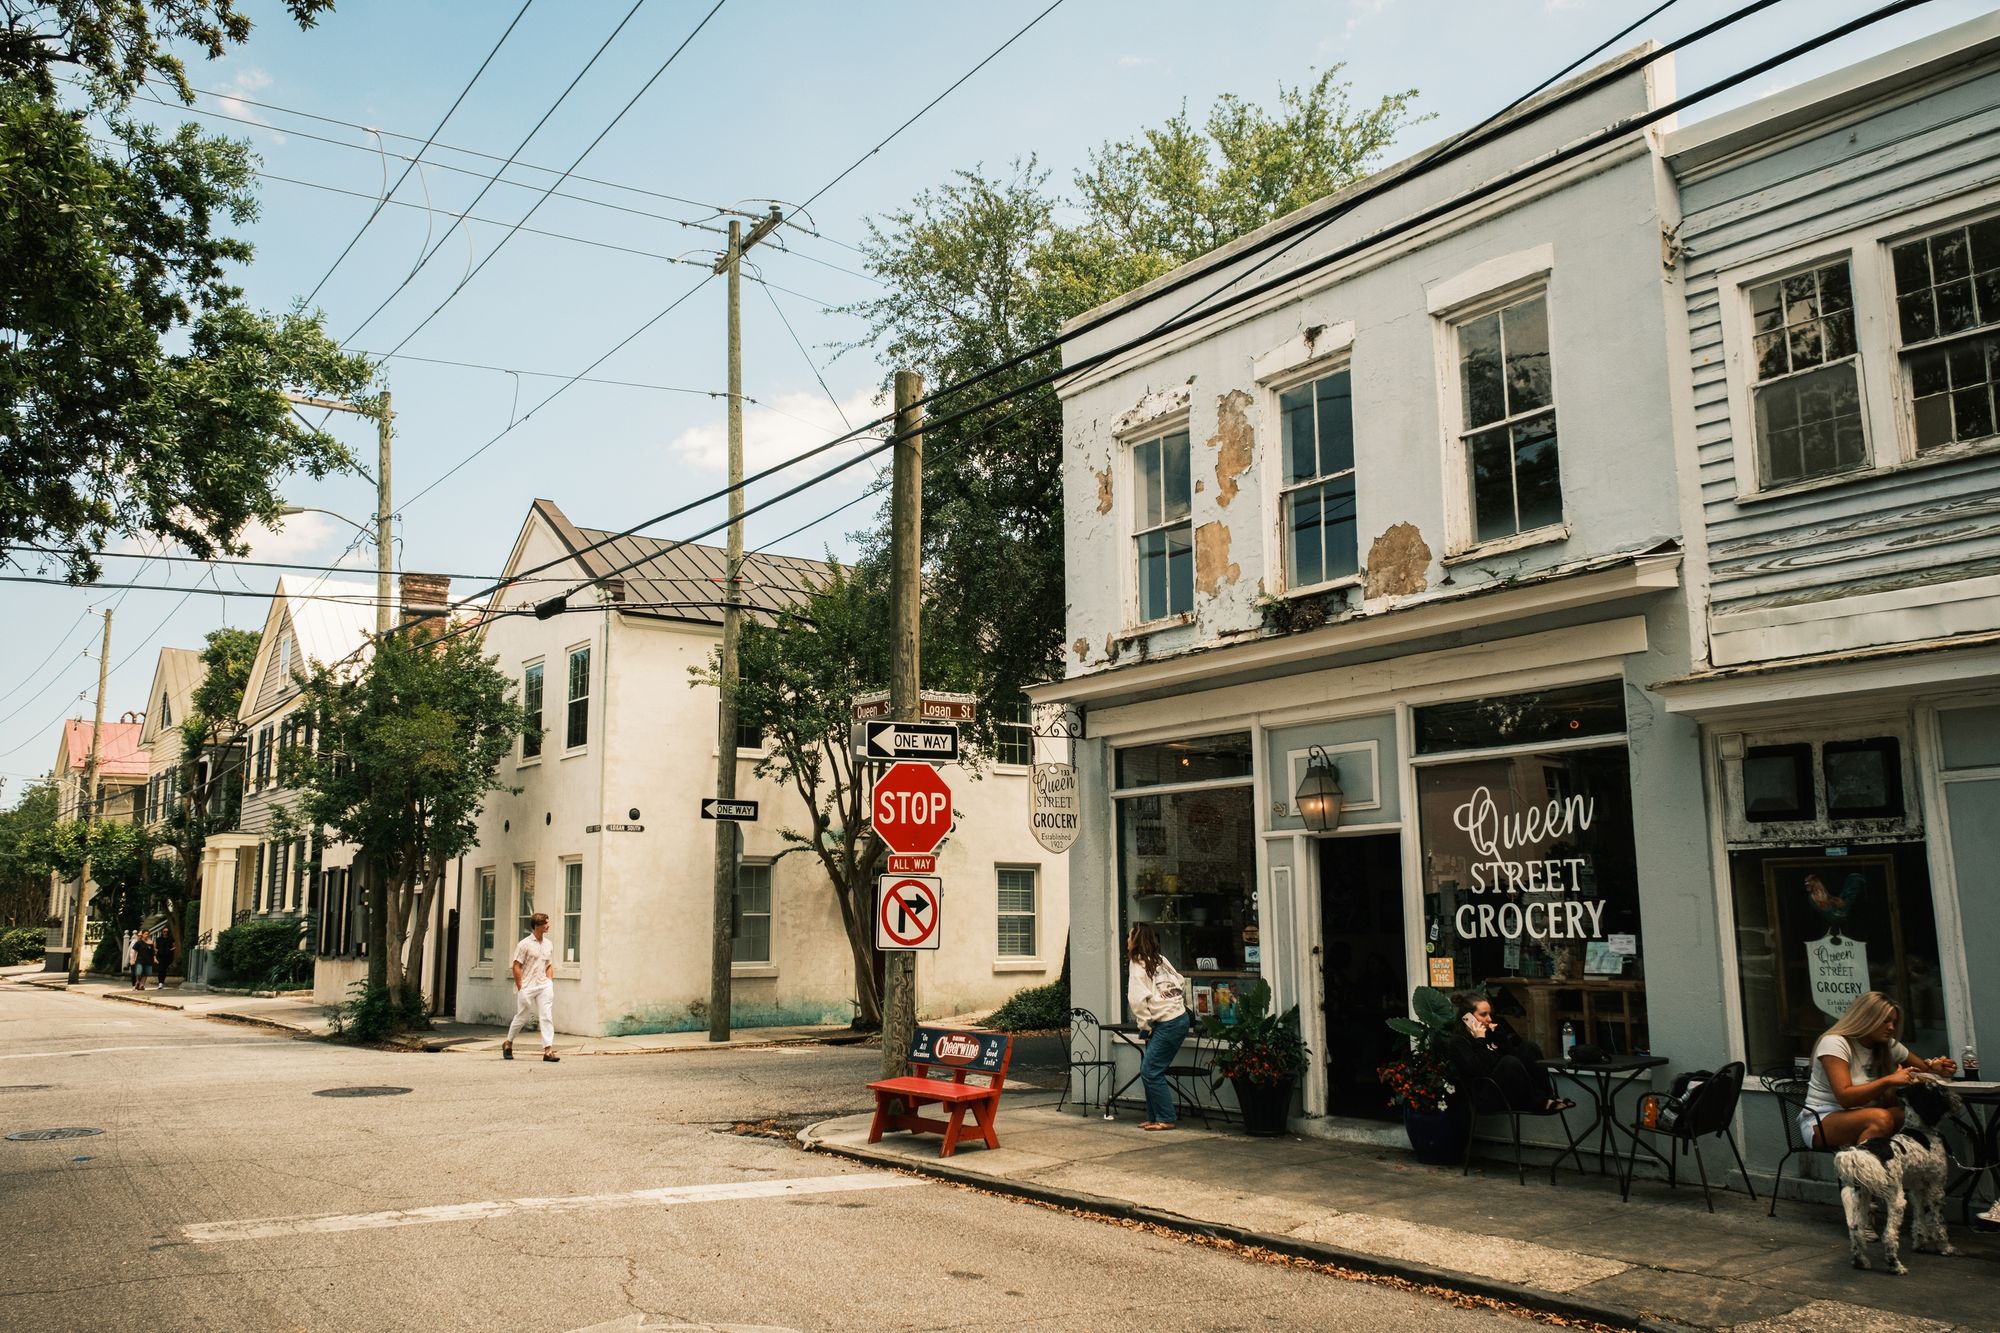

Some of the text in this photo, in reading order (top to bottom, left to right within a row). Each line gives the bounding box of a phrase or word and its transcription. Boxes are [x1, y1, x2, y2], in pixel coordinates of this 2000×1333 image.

[857, 705, 878, 719] Queen
[924, 702, 971, 718] Logan St
[894, 734, 948, 749] ONE WAY
[1060, 769, 1070, 777] 133
[1032, 769, 1075, 799] Queen
[878, 790, 947, 825] STOP
[1037, 796, 1072, 808] STREET
[717, 805, 752, 815] ONE WAY
[1033, 813, 1078, 828] GROCERY
[1453, 786, 1594, 868] Queen
[1041, 832, 1071, 841] Established
[1050, 840, 1064, 849] 1922
[893, 858, 932, 870] ALL WAY
[1471, 858, 1586, 894] STREET
[1455, 899, 1606, 939] GROCERY
[1813, 945, 1855, 965] Queen
[1820, 966, 1854, 977] STREET
[1816, 981, 1863, 994] GROCERY
[919, 1042, 928, 1050] All
[935, 1036, 980, 1059] Cheerwine
[986, 1048, 998, 1057] Good
